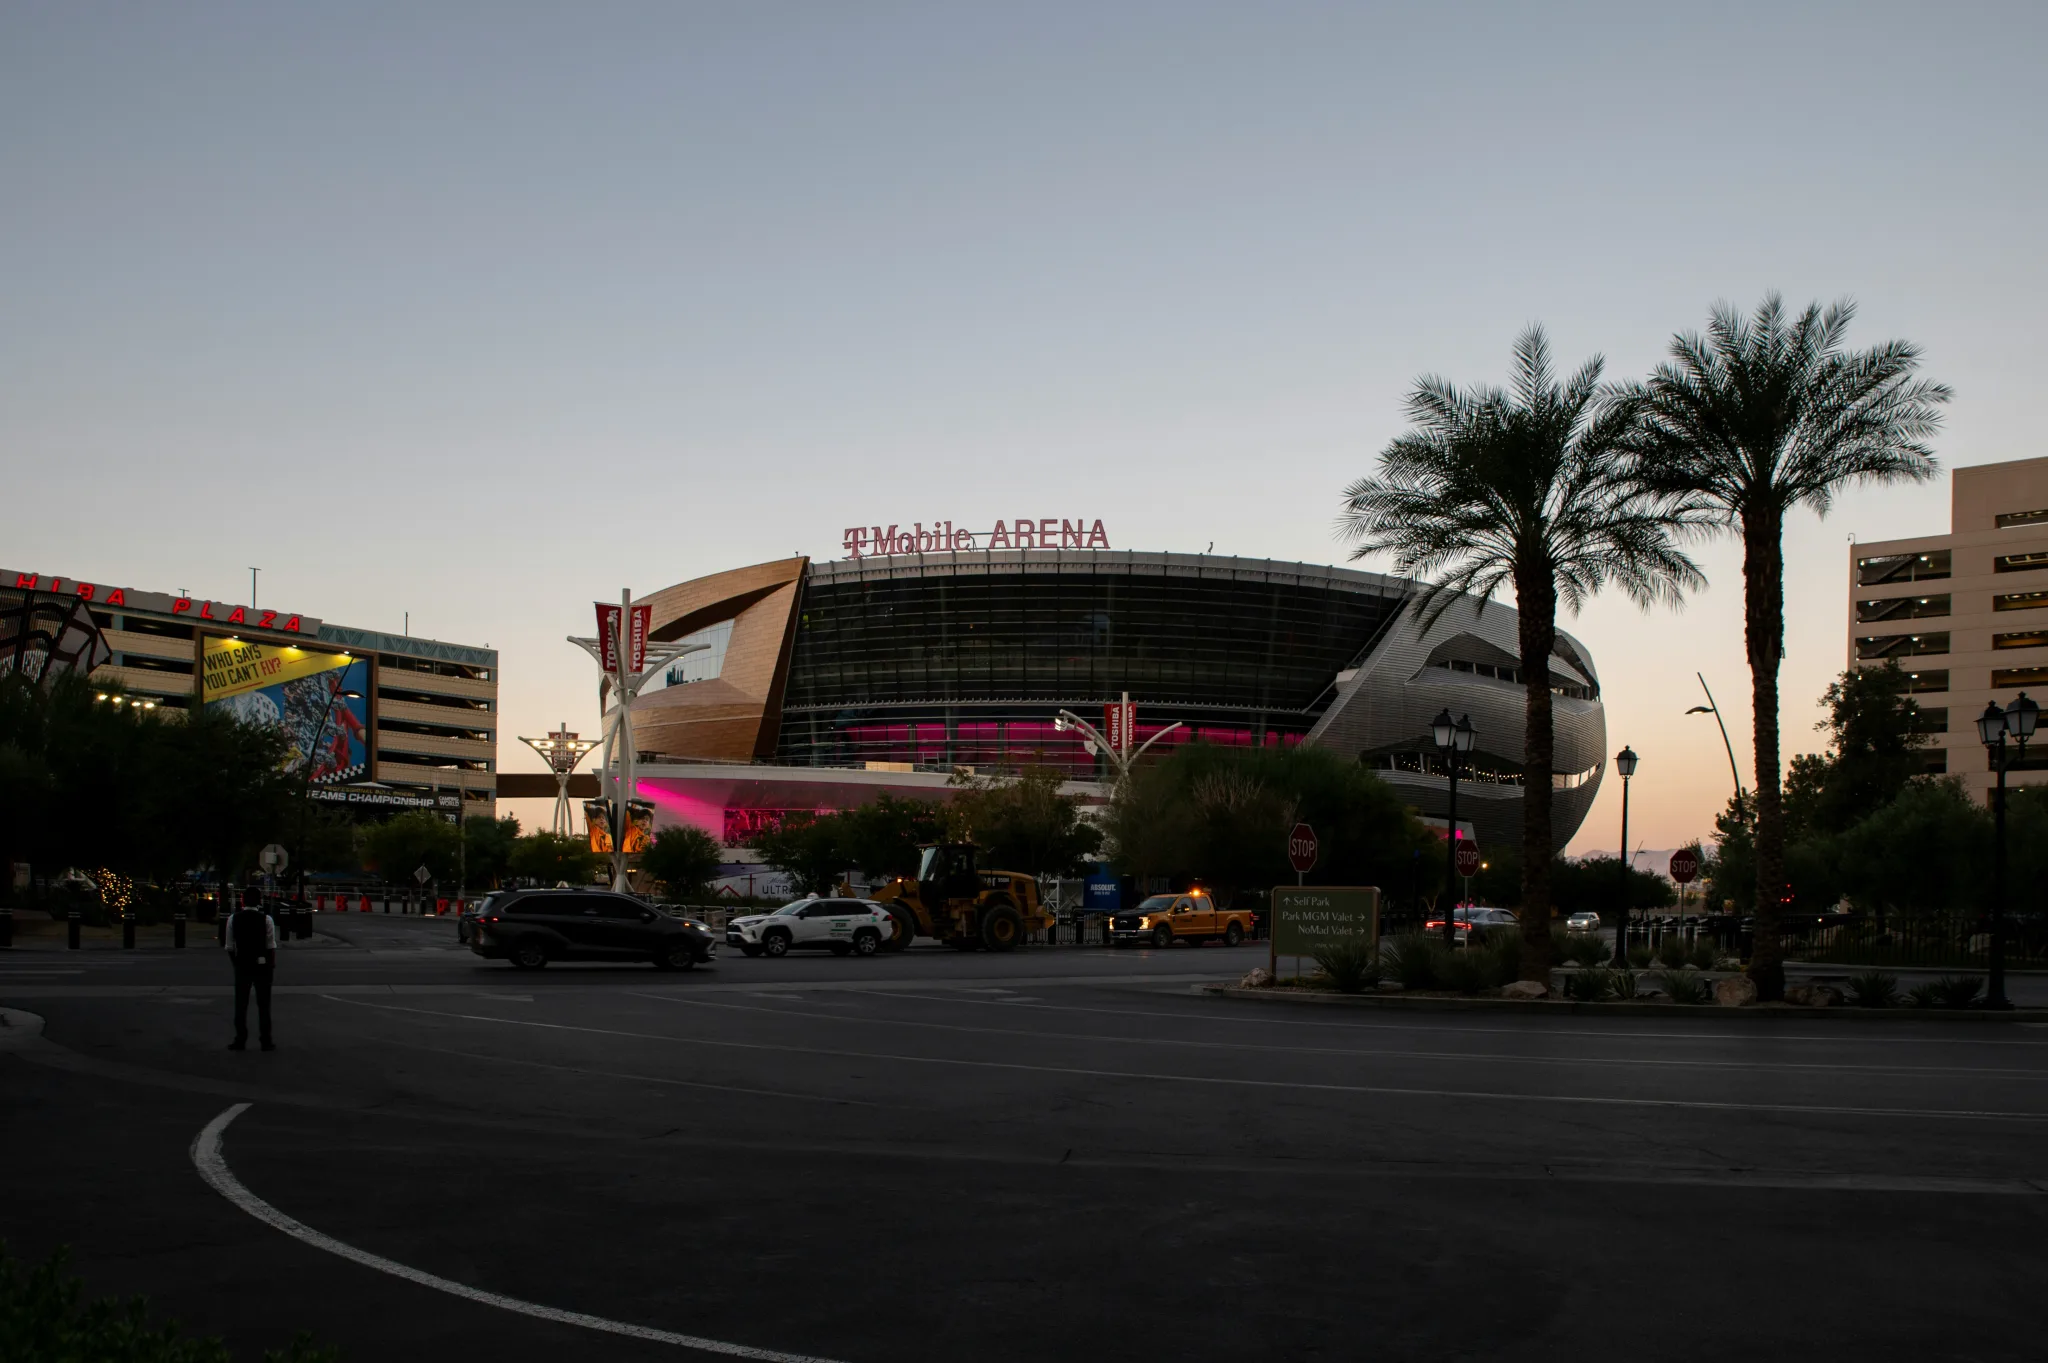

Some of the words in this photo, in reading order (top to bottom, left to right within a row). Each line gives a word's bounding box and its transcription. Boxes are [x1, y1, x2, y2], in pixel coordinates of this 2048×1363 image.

[988, 519, 1110, 549] ARENA
[0, 571, 125, 607] HIBA
[172, 598, 301, 633] PLAZA
[633, 608, 643, 670] TOSHIBA
[203, 650, 234, 671] WHO
[233, 644, 262, 664] SAYS
[202, 671, 228, 691] YOU
[227, 663, 260, 685] CAN'T
[260, 656, 282, 676] FLY?
[1111, 707, 1120, 747] TOSHIBA
[305, 789, 346, 801] TEAMS
[348, 793, 435, 807] CHAMPIONSHIP
[1291, 839, 1315, 857] STOP
[1457, 850, 1478, 865] STOP
[1672, 860, 1697, 873] STOP
[762, 885, 796, 895] ULTRA
[1293, 896, 1310, 906] Self
[1311, 896, 1331, 907] Park
[1282, 911, 1301, 921] Park
[1302, 911, 1330, 921] MGM
[1331, 911, 1354, 922] Valet
[1298, 924, 1330, 936] NoMad
[1331, 925, 1354, 936] Valet
